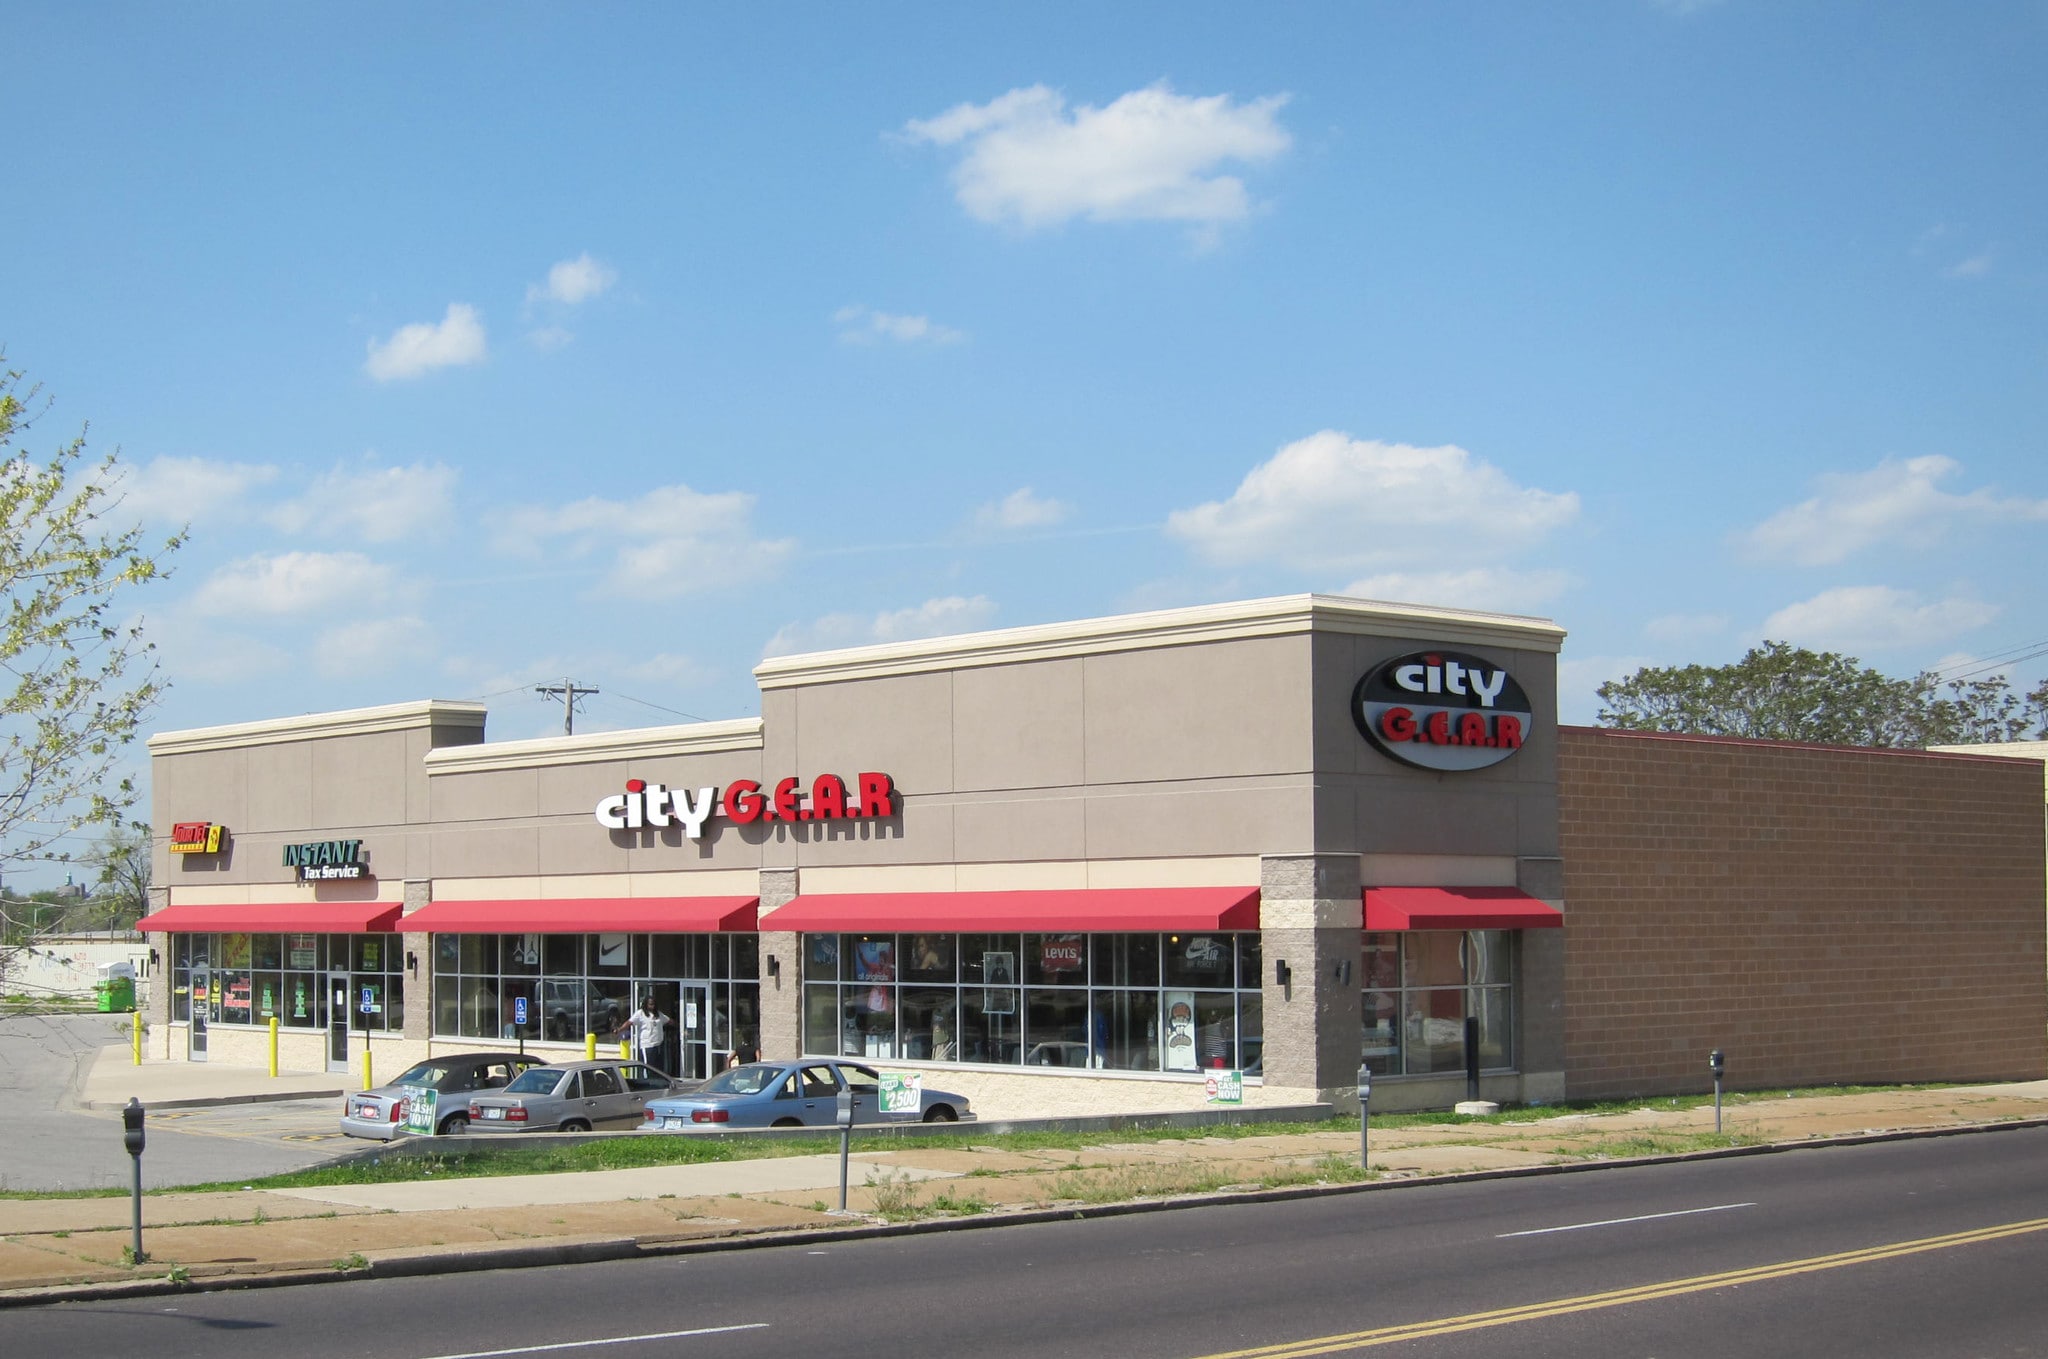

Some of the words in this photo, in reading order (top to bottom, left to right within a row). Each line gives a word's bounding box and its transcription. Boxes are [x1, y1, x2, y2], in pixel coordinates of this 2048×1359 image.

[1395, 656, 1506, 707] city
[595, 779, 716, 838] city
[283, 839, 360, 866] INSTANT
[304, 866, 321, 879] Tax
[322, 865, 359, 879] Service
[1203, 949, 1219, 960] AIR
[1217, 1081, 1240, 1091] CASH
[1217, 1089, 1240, 1100] NOW
[410, 1102, 433, 1115] CASH
